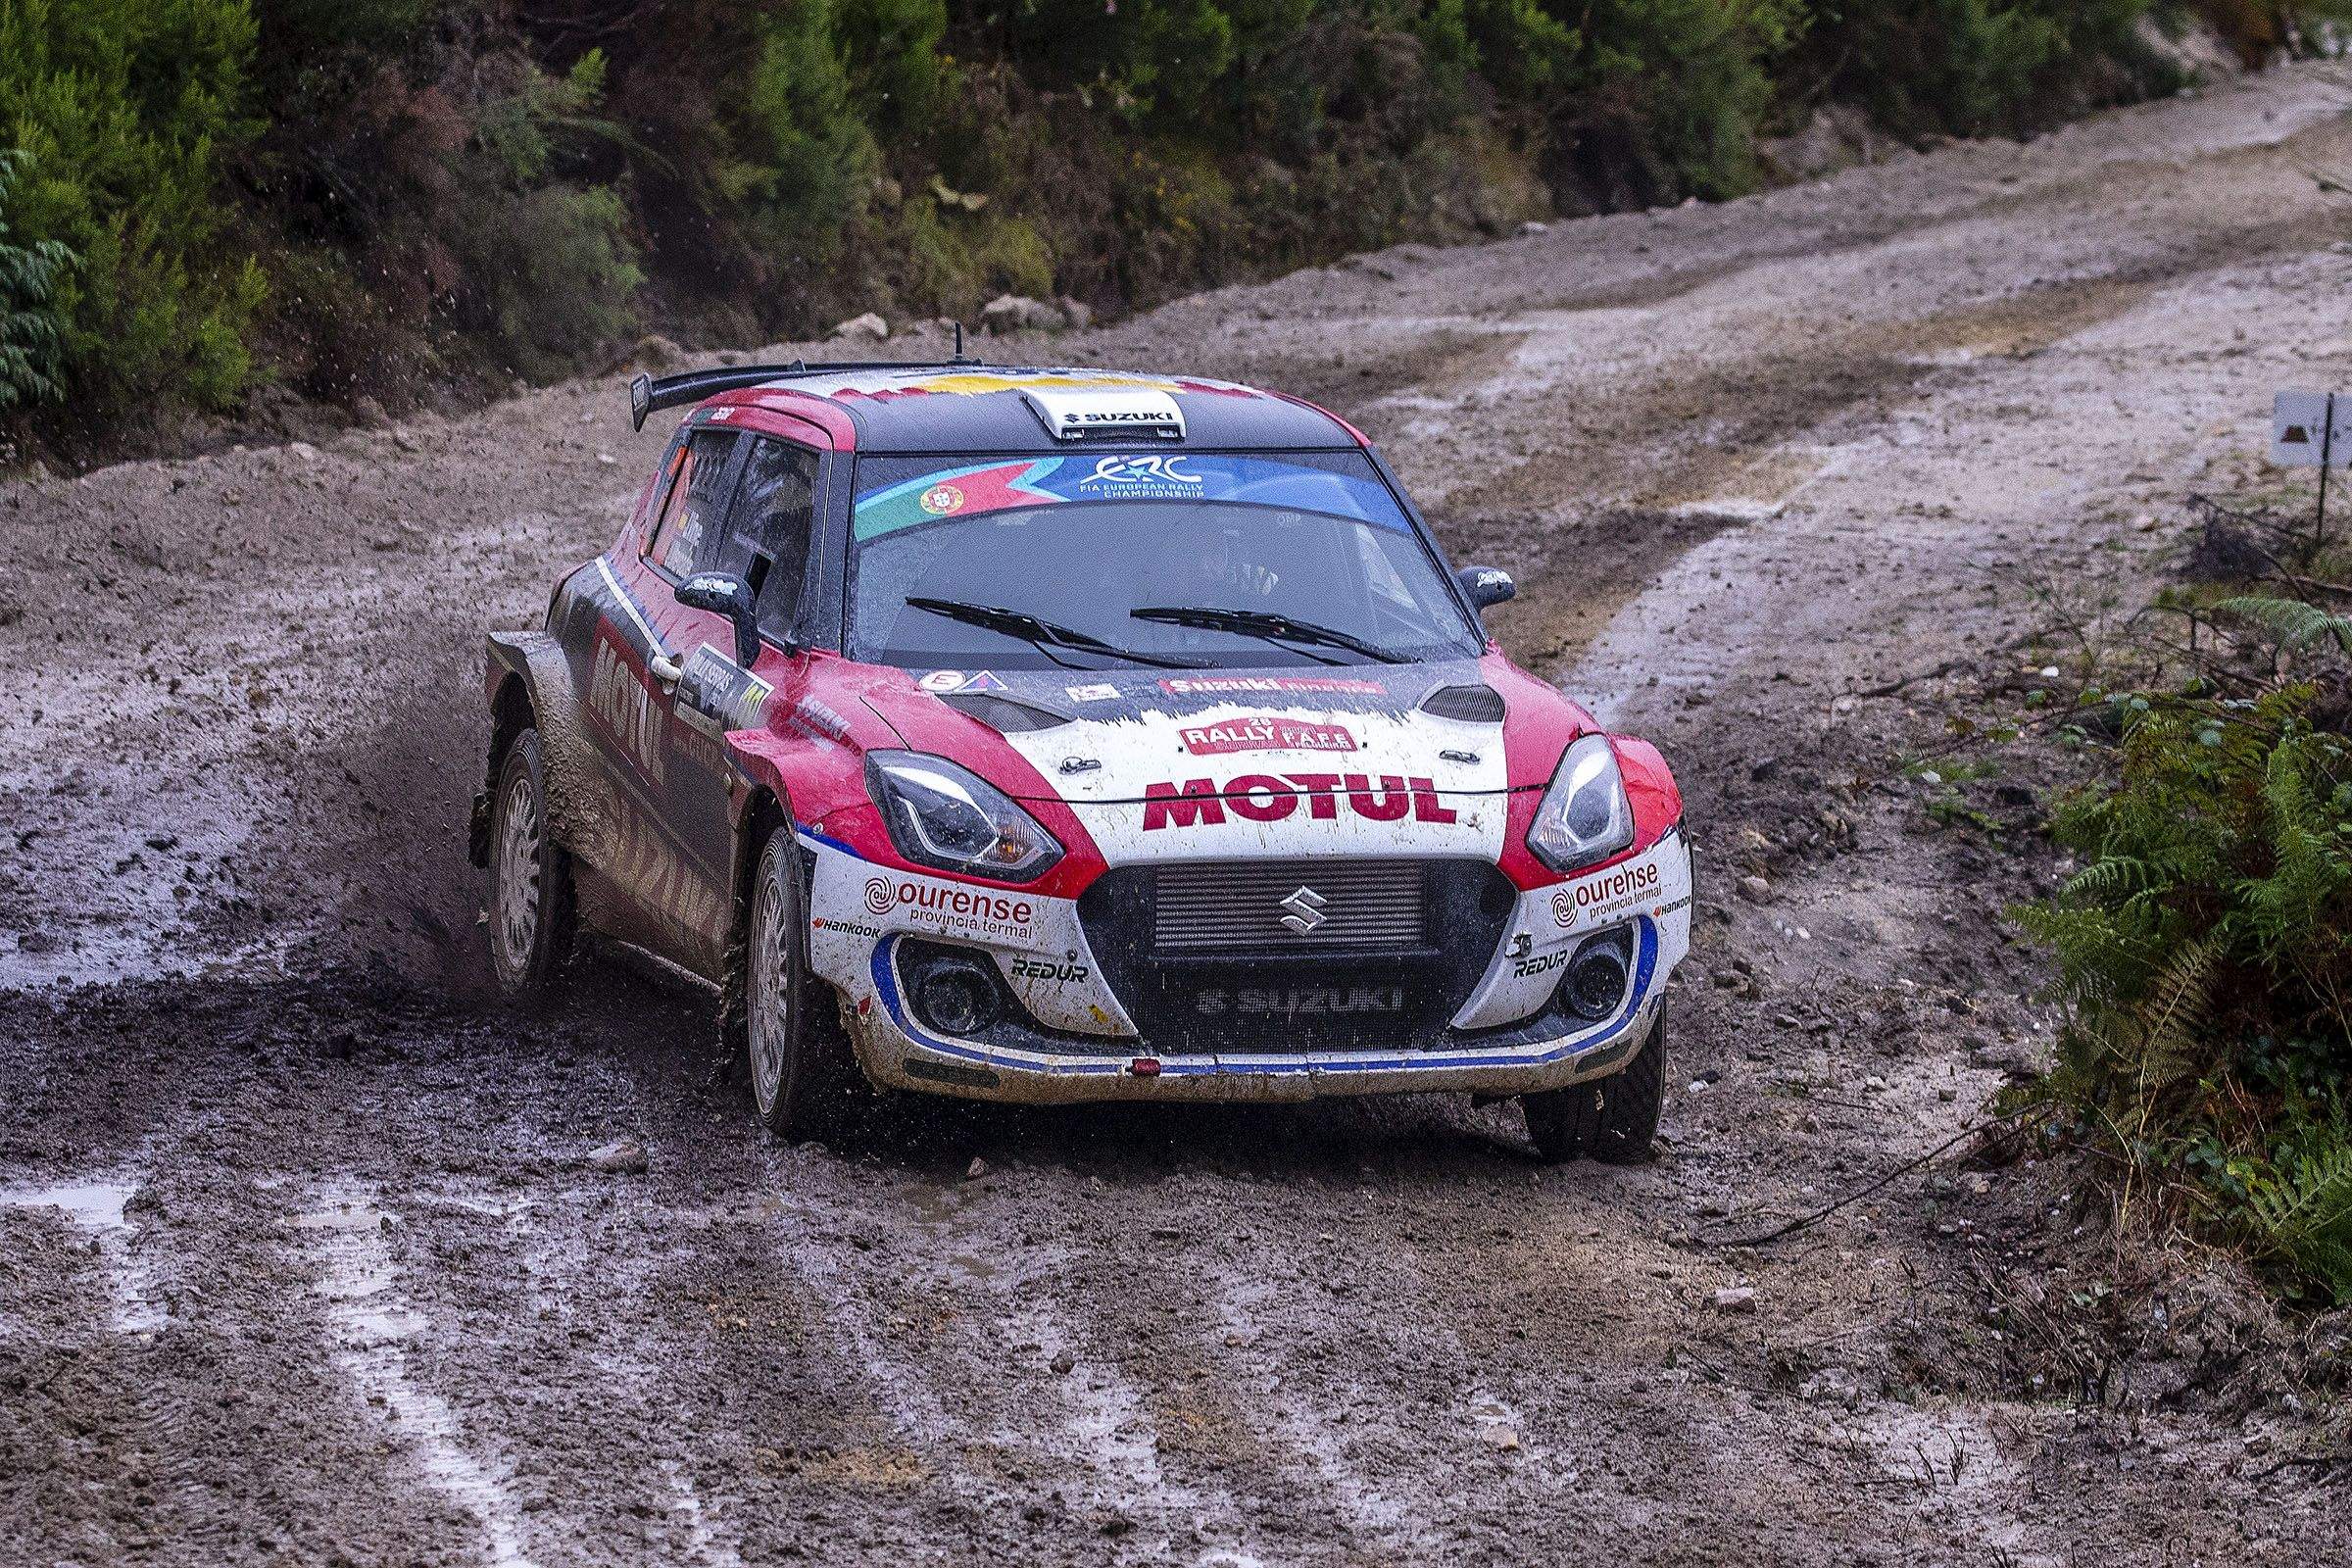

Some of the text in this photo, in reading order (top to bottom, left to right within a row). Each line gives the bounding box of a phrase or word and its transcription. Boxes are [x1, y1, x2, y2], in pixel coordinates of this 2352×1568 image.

[1085, 413, 1174, 422] SUZUKI
[1080, 456, 1202, 484] ERC
[1080, 483, 1203, 493] FIA EUROPEAN RALLY
[1103, 490, 1204, 499] CHAMPIONSHIP
[1169, 677, 1284, 694] Suzuki
[590, 636, 665, 788] MOTUL
[1185, 725, 1275, 745] RALLY
[1143, 774, 1457, 831] MOTUL
[1576, 862, 1658, 906] ourense
[897, 882, 1032, 924] ourense
[1590, 883, 1662, 922] provincia termal
[983, 918, 1032, 940] termal
[1011, 957, 1089, 984] REDUR
[1514, 949, 1568, 979] REDUR
[1237, 988, 1403, 1012] SUZUKI
